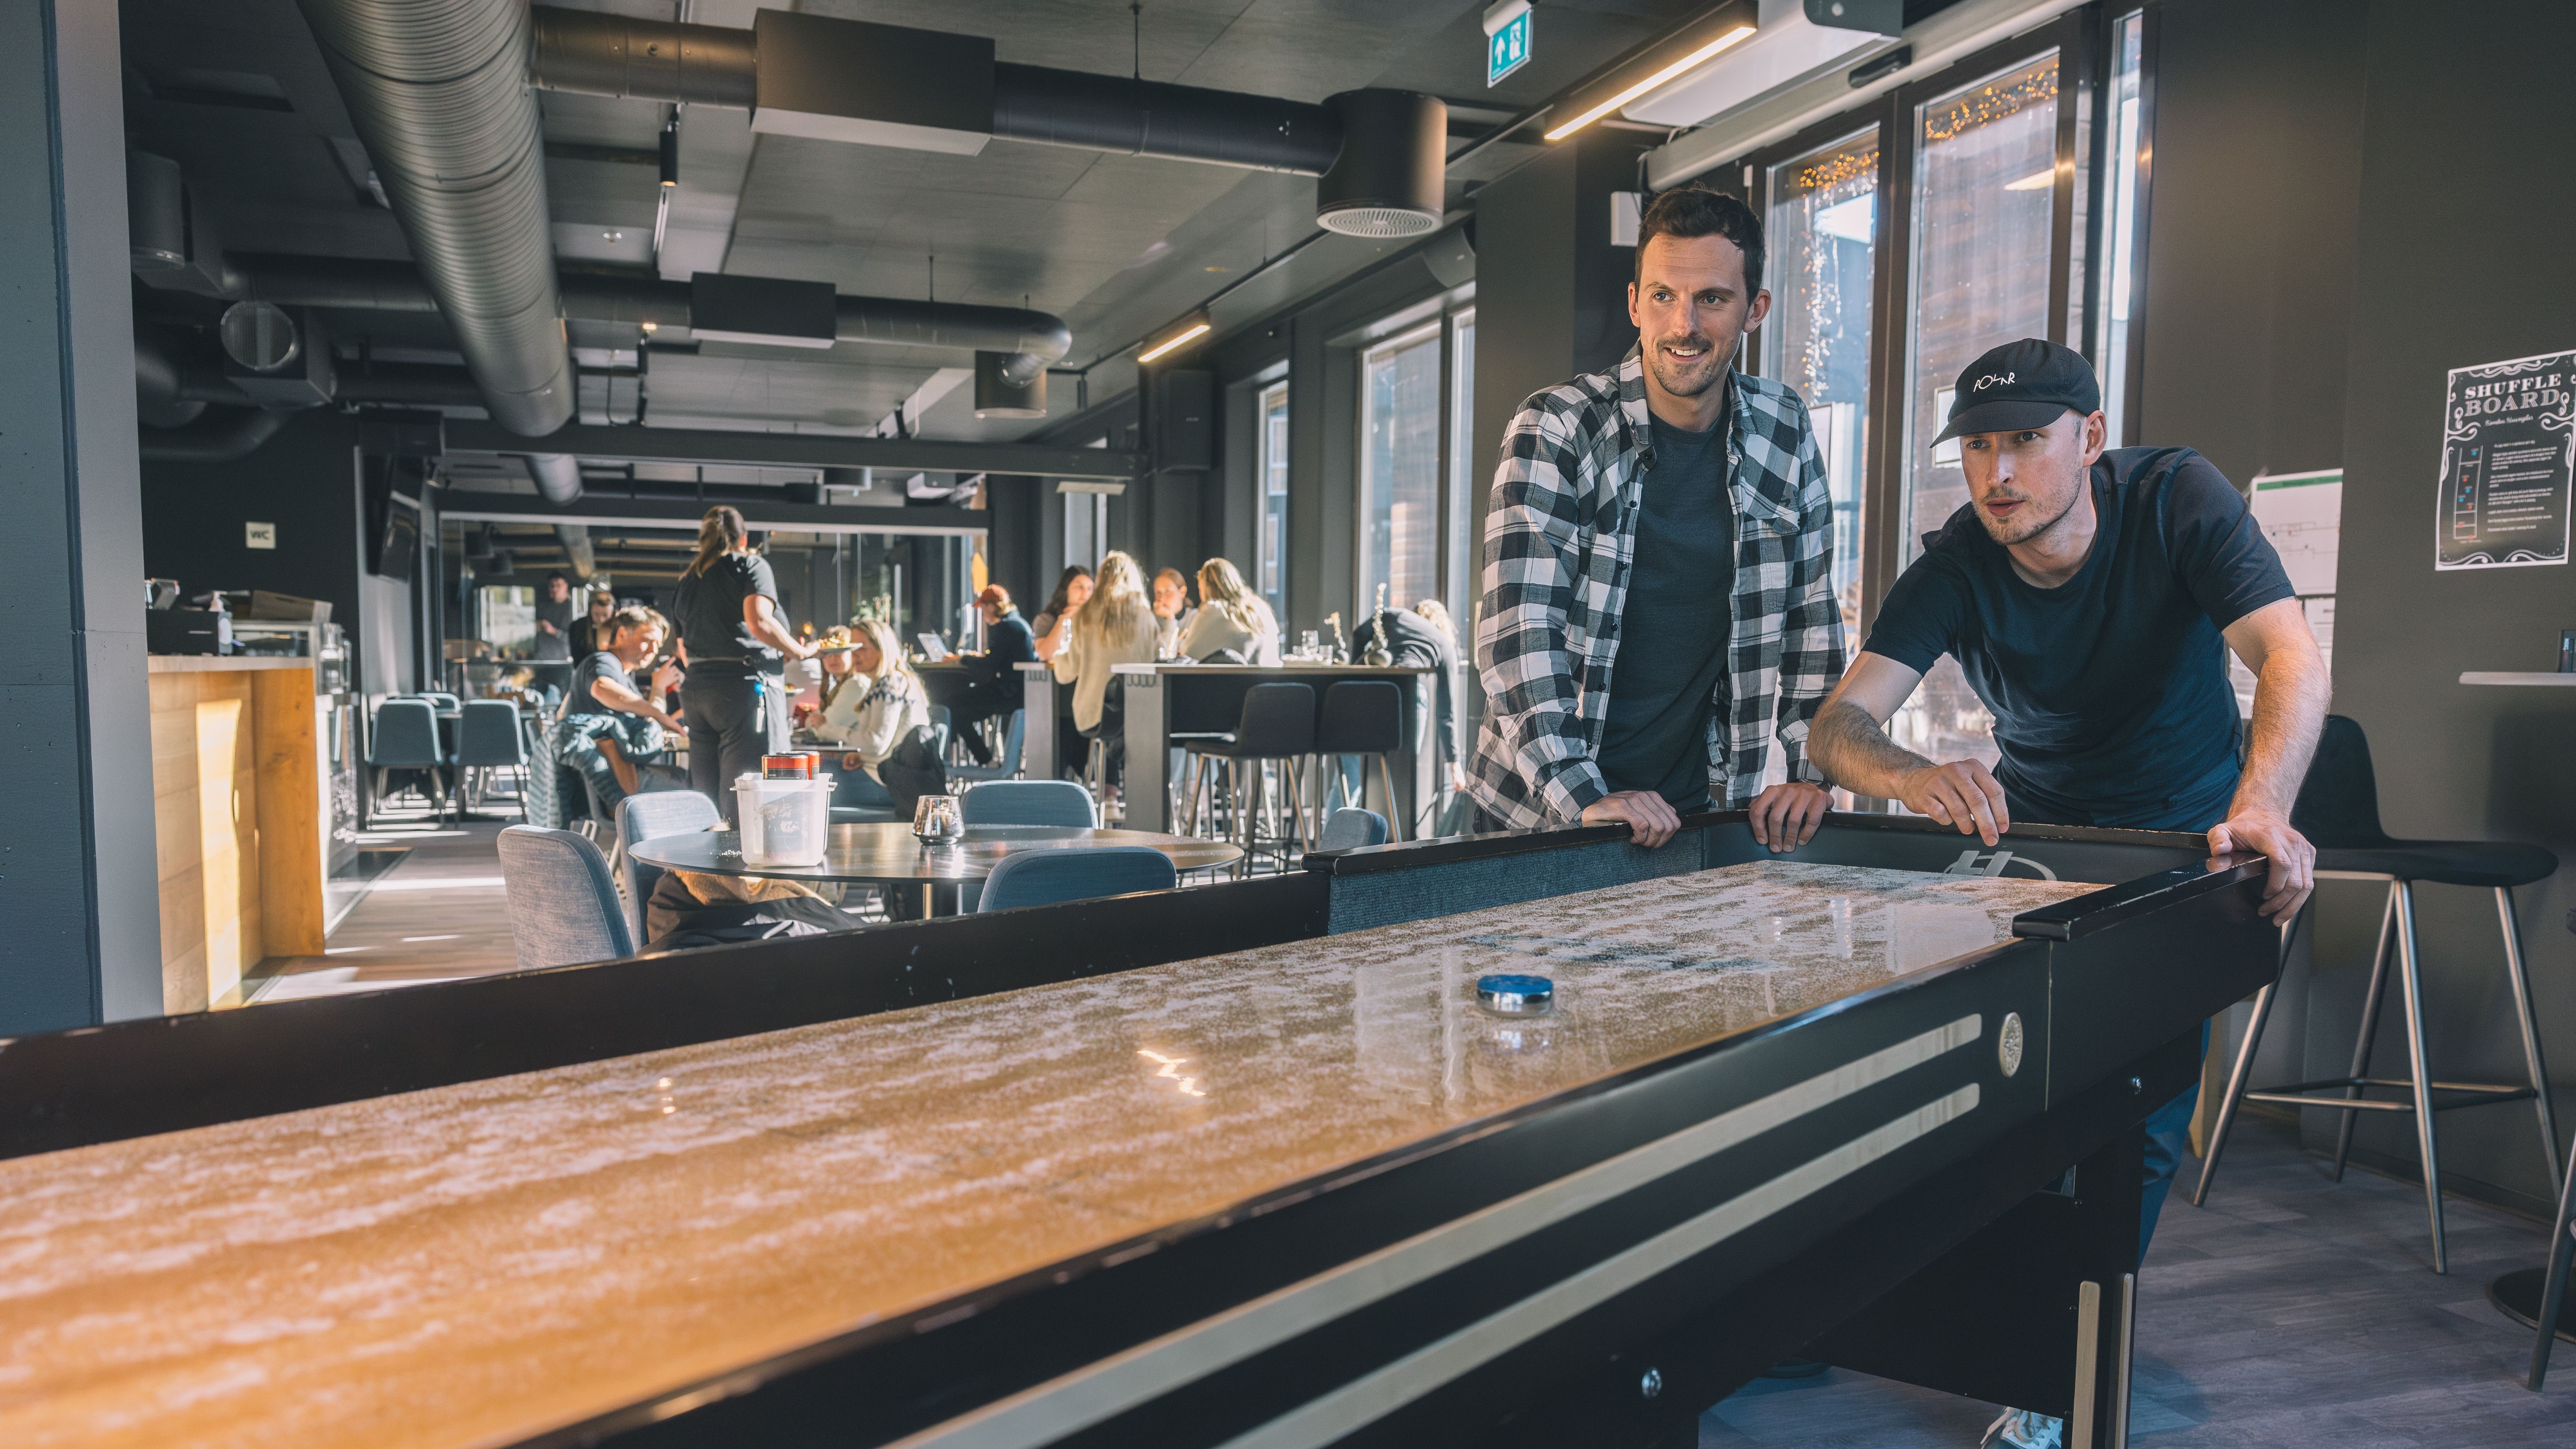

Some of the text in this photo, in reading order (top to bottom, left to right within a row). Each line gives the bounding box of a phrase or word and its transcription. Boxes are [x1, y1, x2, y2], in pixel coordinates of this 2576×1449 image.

[1973, 372, 2015, 392] POLAR
[2464, 373, 2561, 400] SHUFFLE
[2464, 388, 2560, 417] BOARD
[250, 530, 270, 540] WC
